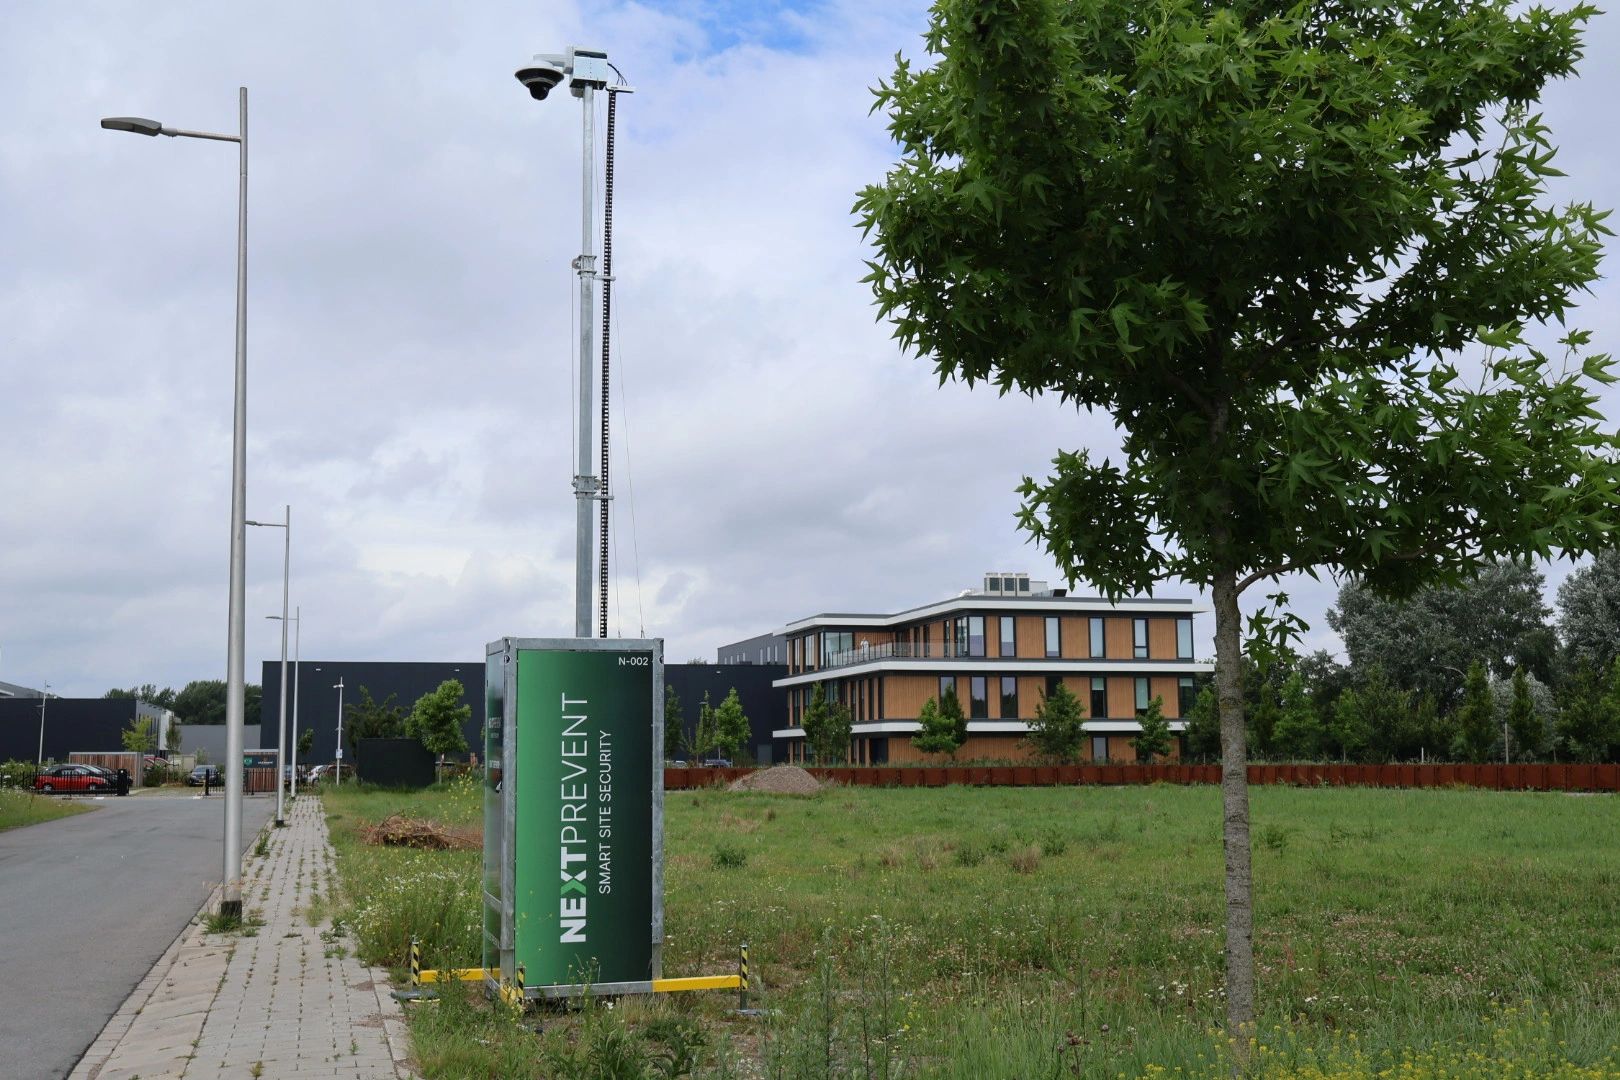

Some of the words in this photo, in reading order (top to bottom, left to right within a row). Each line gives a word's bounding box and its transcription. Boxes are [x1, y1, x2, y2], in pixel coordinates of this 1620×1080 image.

[618, 656, 649, 666] N-002
[599, 730, 612, 802] SECURITY
[560, 692, 588, 943] NEXTPREVENT
[599, 806, 612, 838] SITE
[598, 843, 612, 894] SMART
